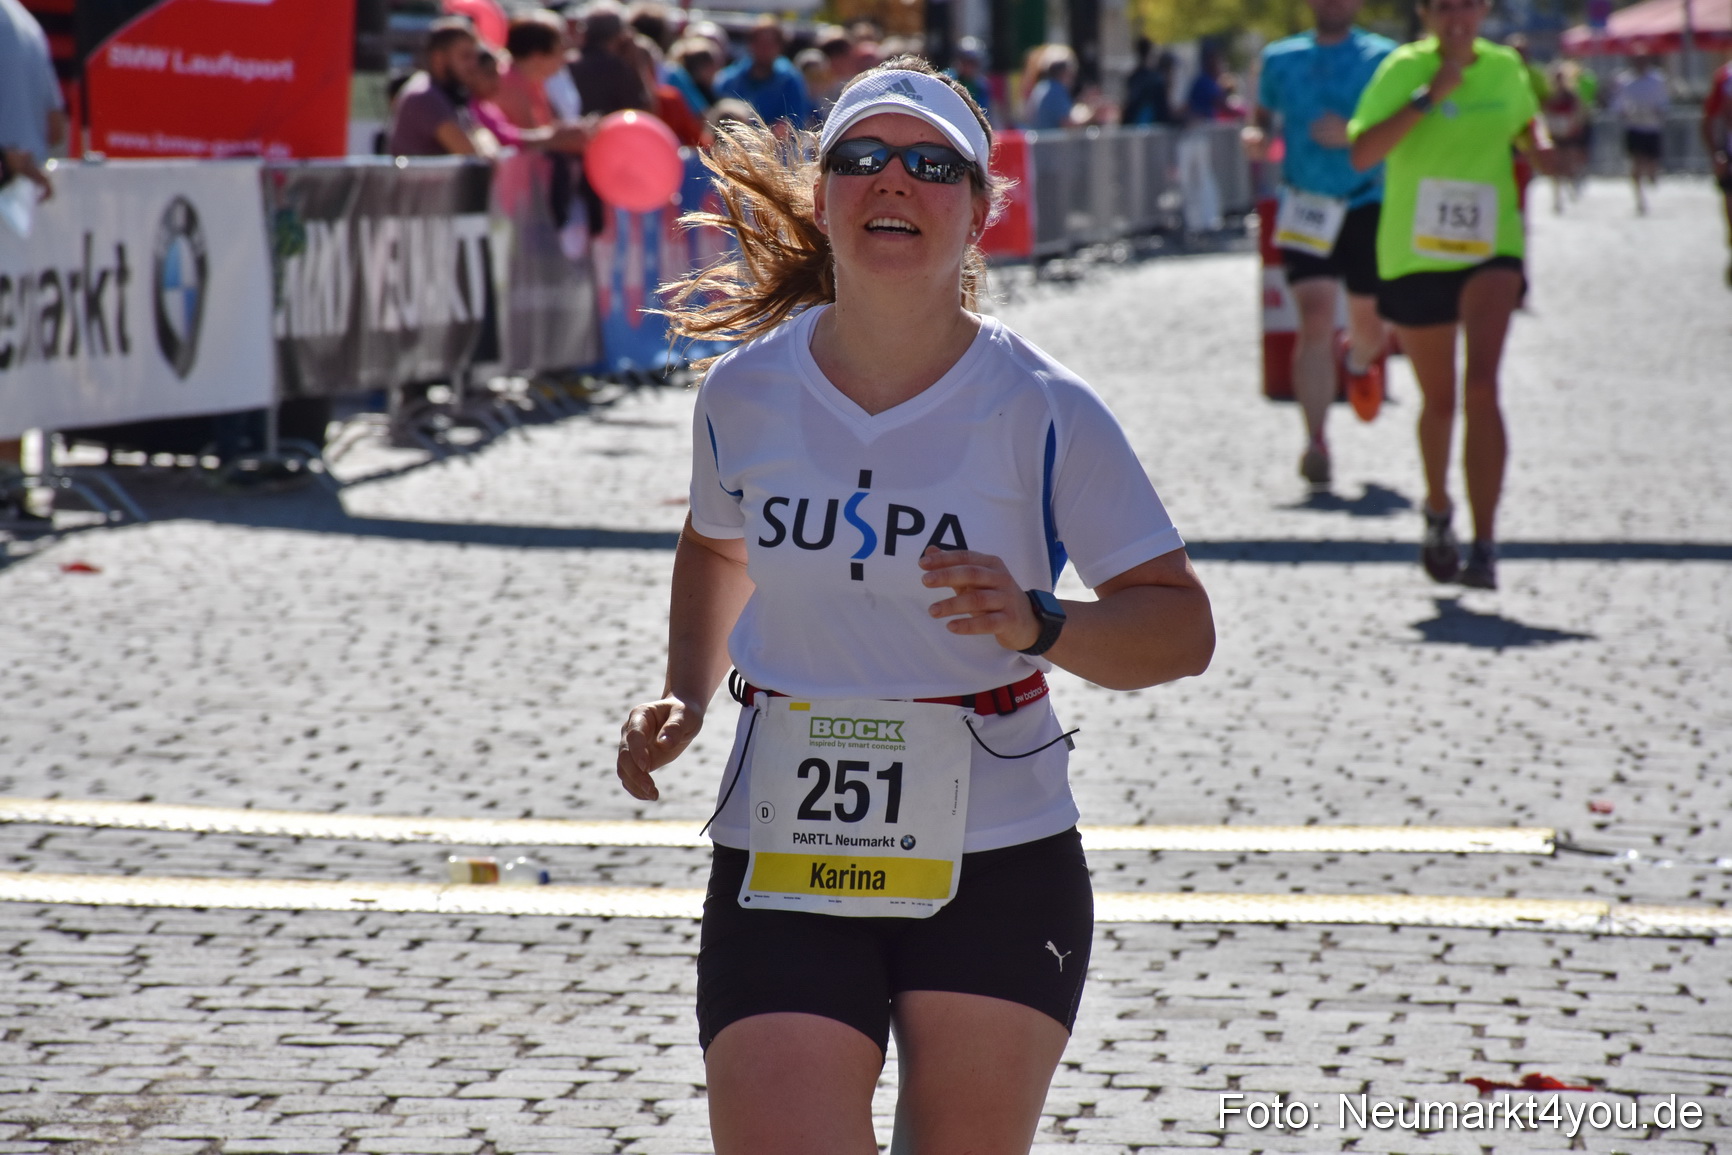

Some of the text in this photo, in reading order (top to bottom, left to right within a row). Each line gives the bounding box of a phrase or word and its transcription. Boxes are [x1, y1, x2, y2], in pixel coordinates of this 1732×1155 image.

[171, 50, 294, 82] Laufsport
[758, 482, 969, 564] SUSPA
[809, 716, 905, 742] BOCK
[808, 740, 906, 752] inspired by smart concepts
[797, 757, 903, 824] 251
[761, 807, 769, 819] D
[793, 832, 895, 848] PARTL Neumarkt
[810, 862, 886, 890] Karina
